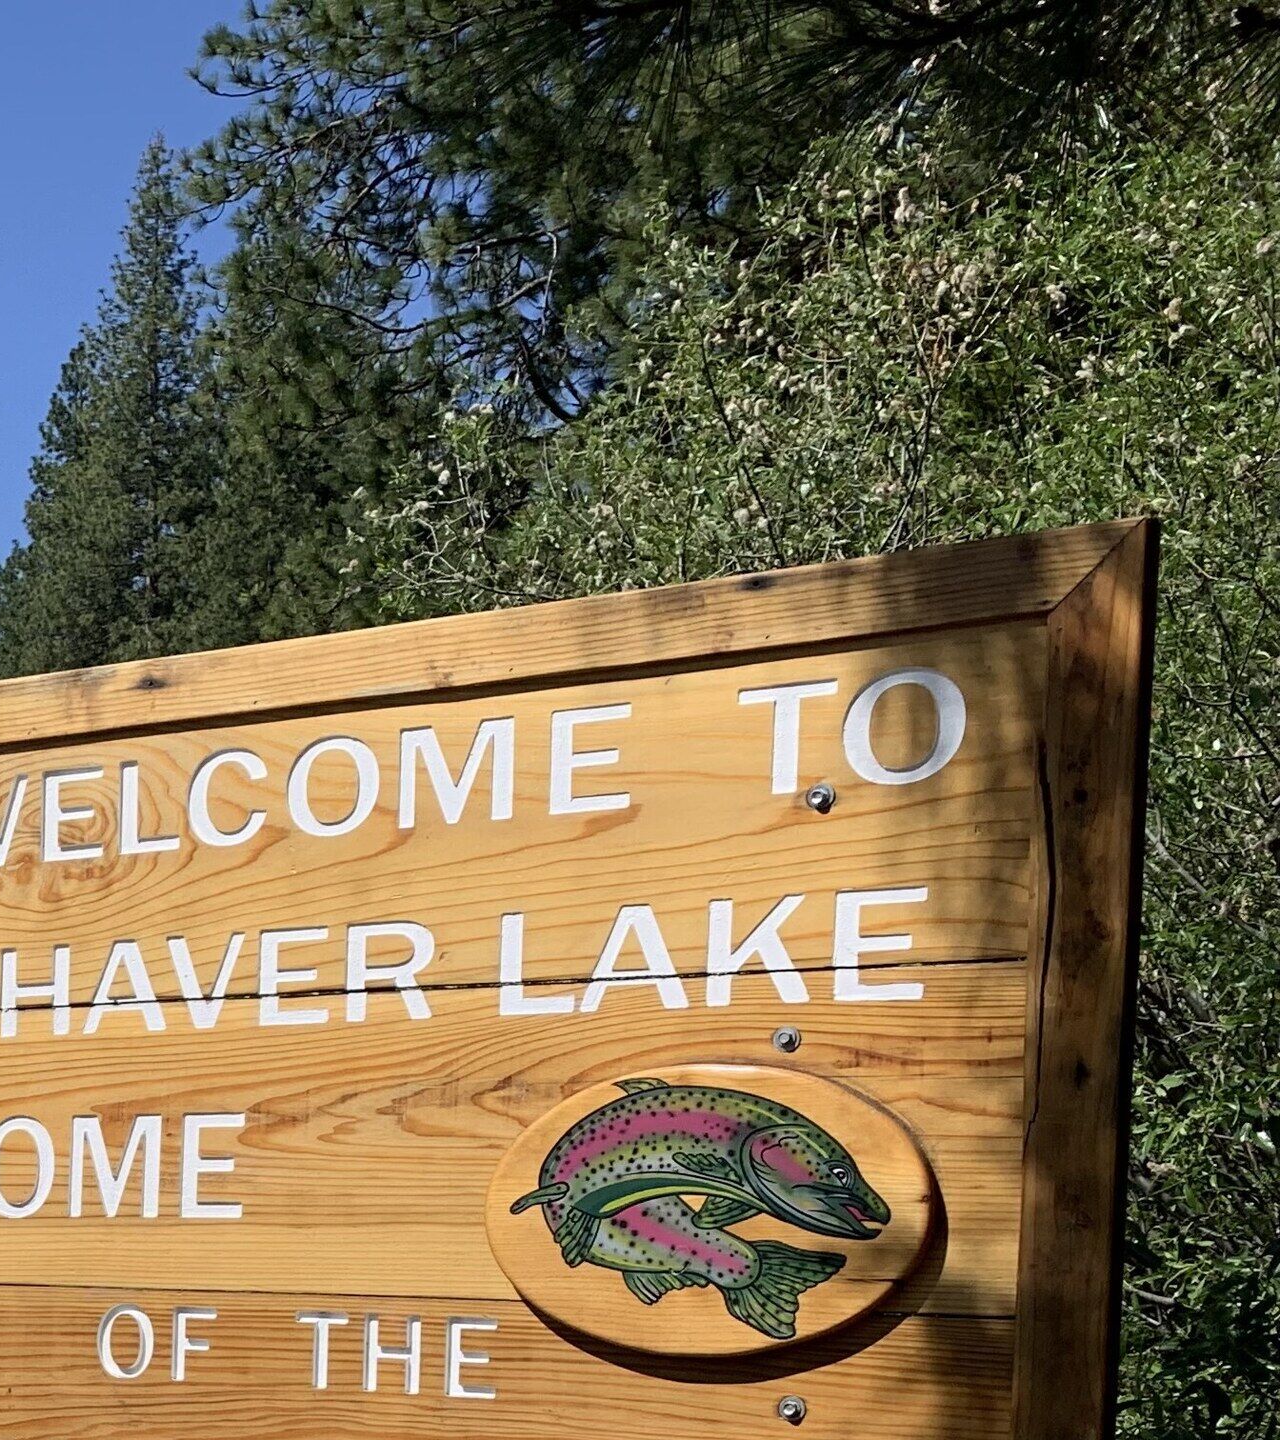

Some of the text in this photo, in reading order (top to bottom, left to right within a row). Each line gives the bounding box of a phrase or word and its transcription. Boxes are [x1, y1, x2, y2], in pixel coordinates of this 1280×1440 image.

[738, 668, 967, 796] TO
[496, 887, 928, 1016] LAKE
[97, 1304, 497, 1399] OF THE
